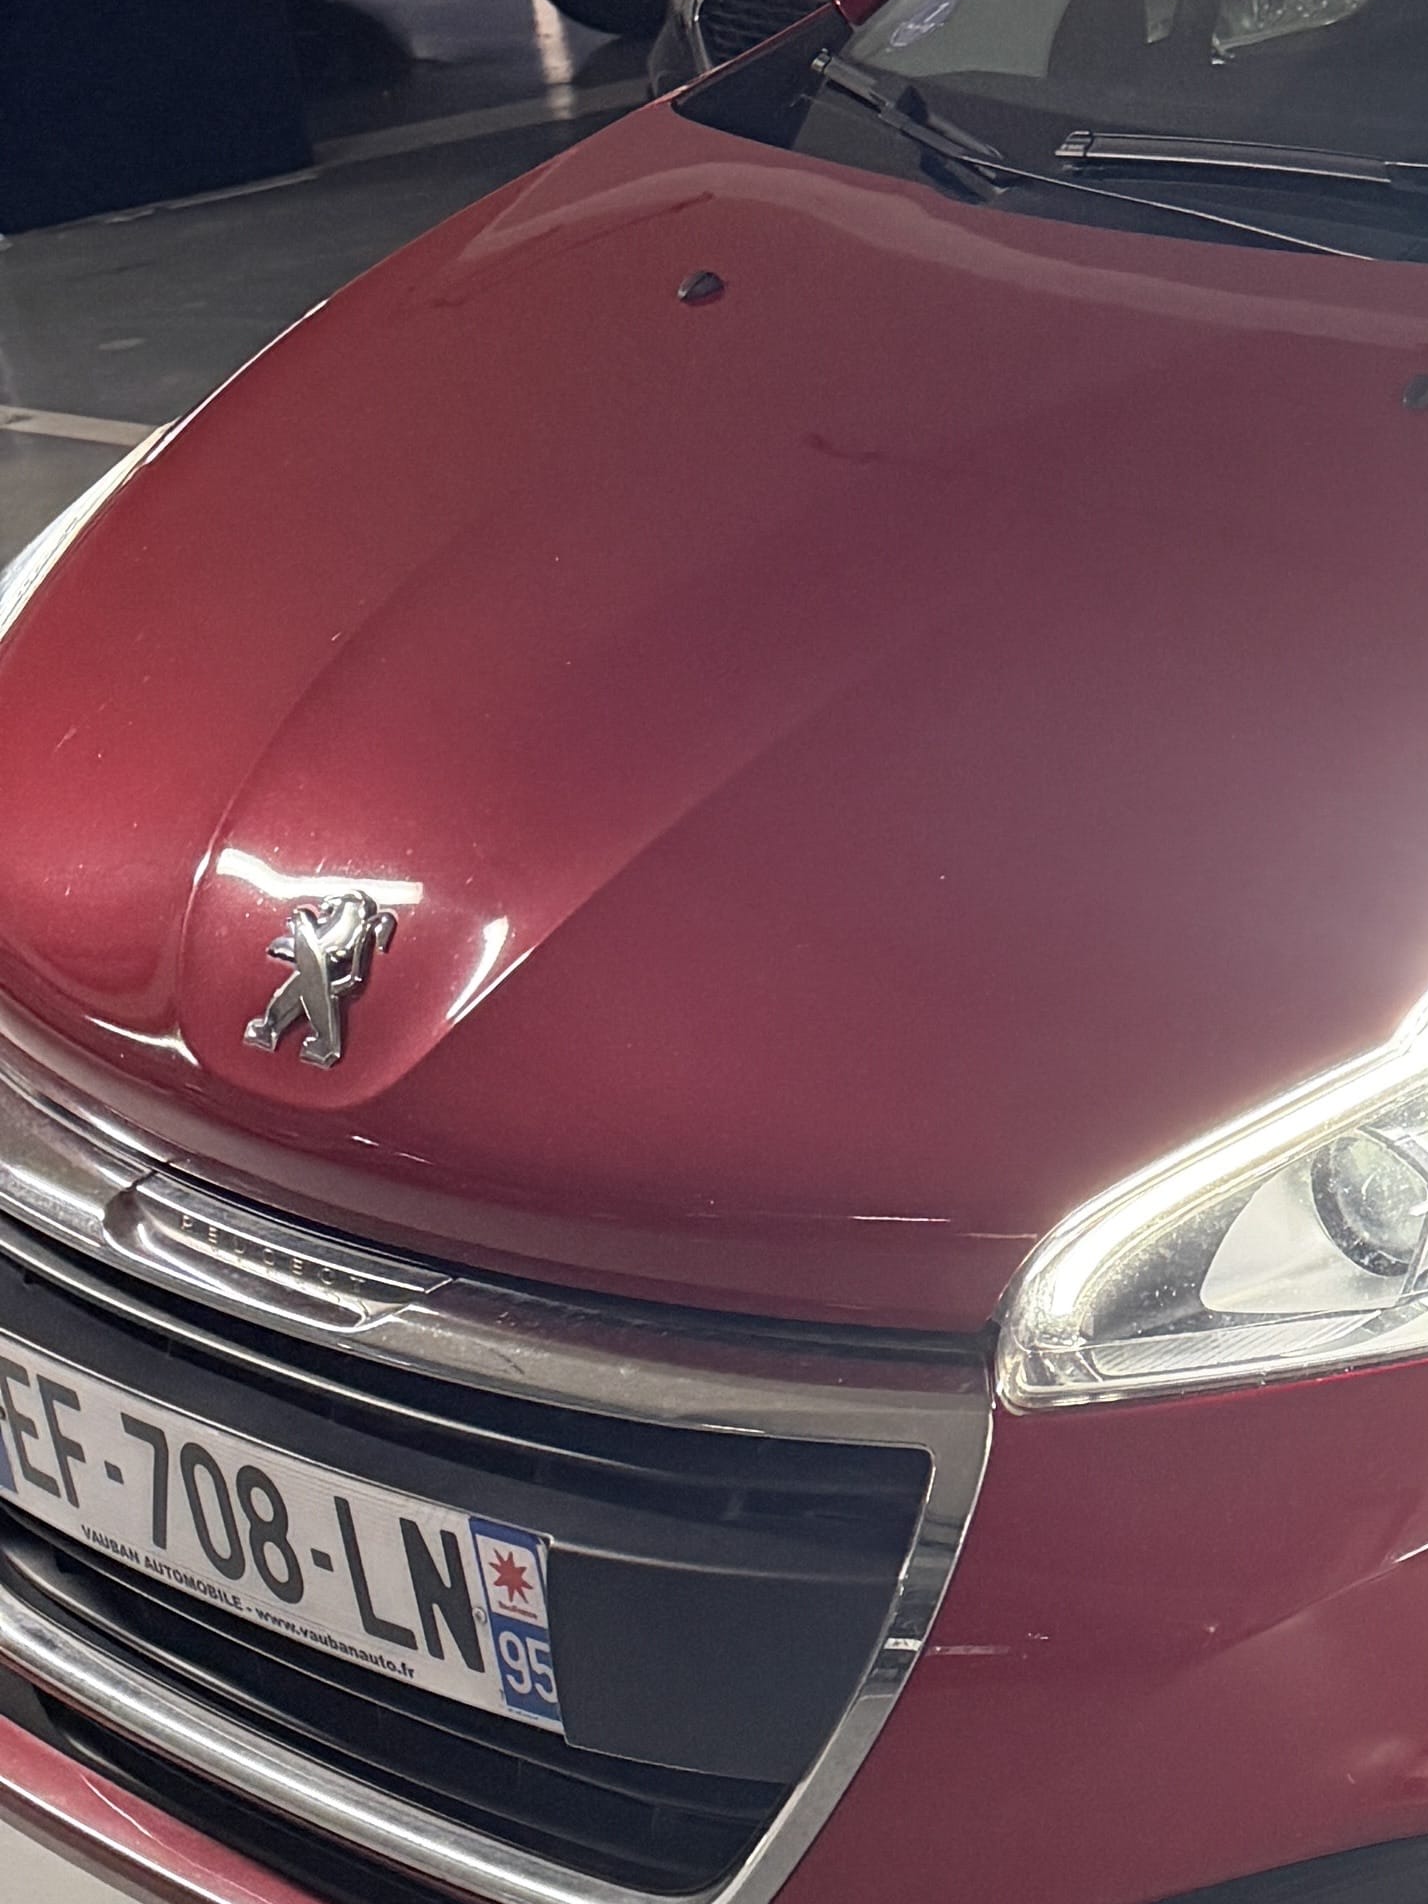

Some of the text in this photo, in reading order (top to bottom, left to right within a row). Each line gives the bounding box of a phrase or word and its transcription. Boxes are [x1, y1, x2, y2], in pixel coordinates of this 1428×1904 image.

[180, 1214, 366, 1294] PEUGEOT
[0, 1356, 485, 1673] EF-708-LN
[81, 1524, 140, 1564] VAUBAN
[144, 1556, 243, 1611] AUTOMOBILE
[255, 1607, 415, 1679] www.vaubanauto.fr
[500, 1631, 558, 1703] 95
